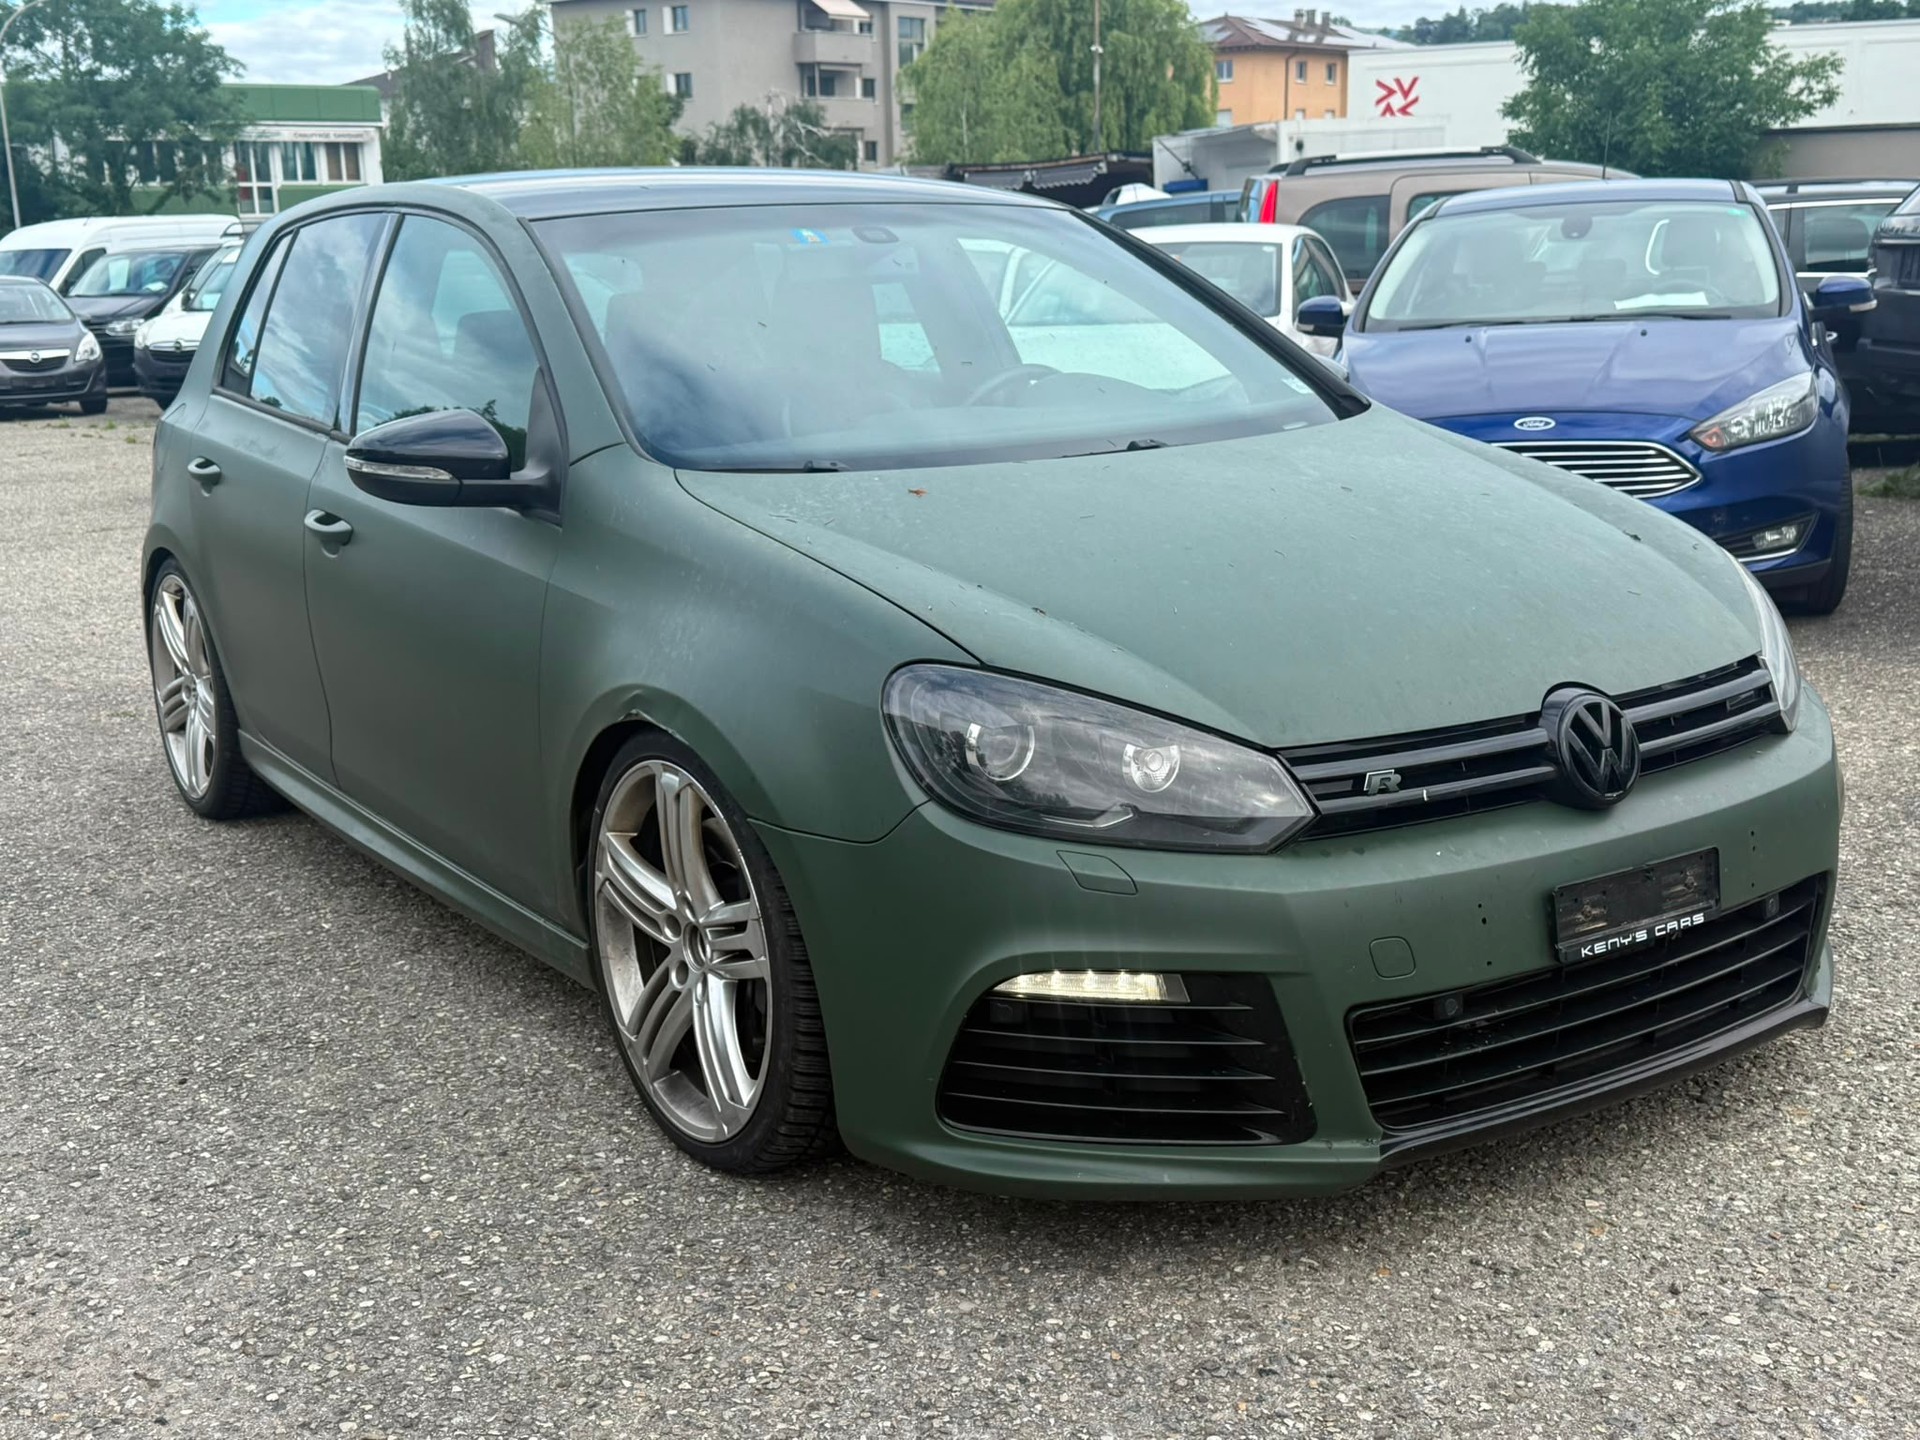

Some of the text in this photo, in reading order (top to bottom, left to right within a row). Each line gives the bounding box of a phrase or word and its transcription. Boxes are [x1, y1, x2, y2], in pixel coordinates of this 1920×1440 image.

[1364, 769, 1401, 795] R
[1581, 912, 1705, 958] KENY'S CARS
